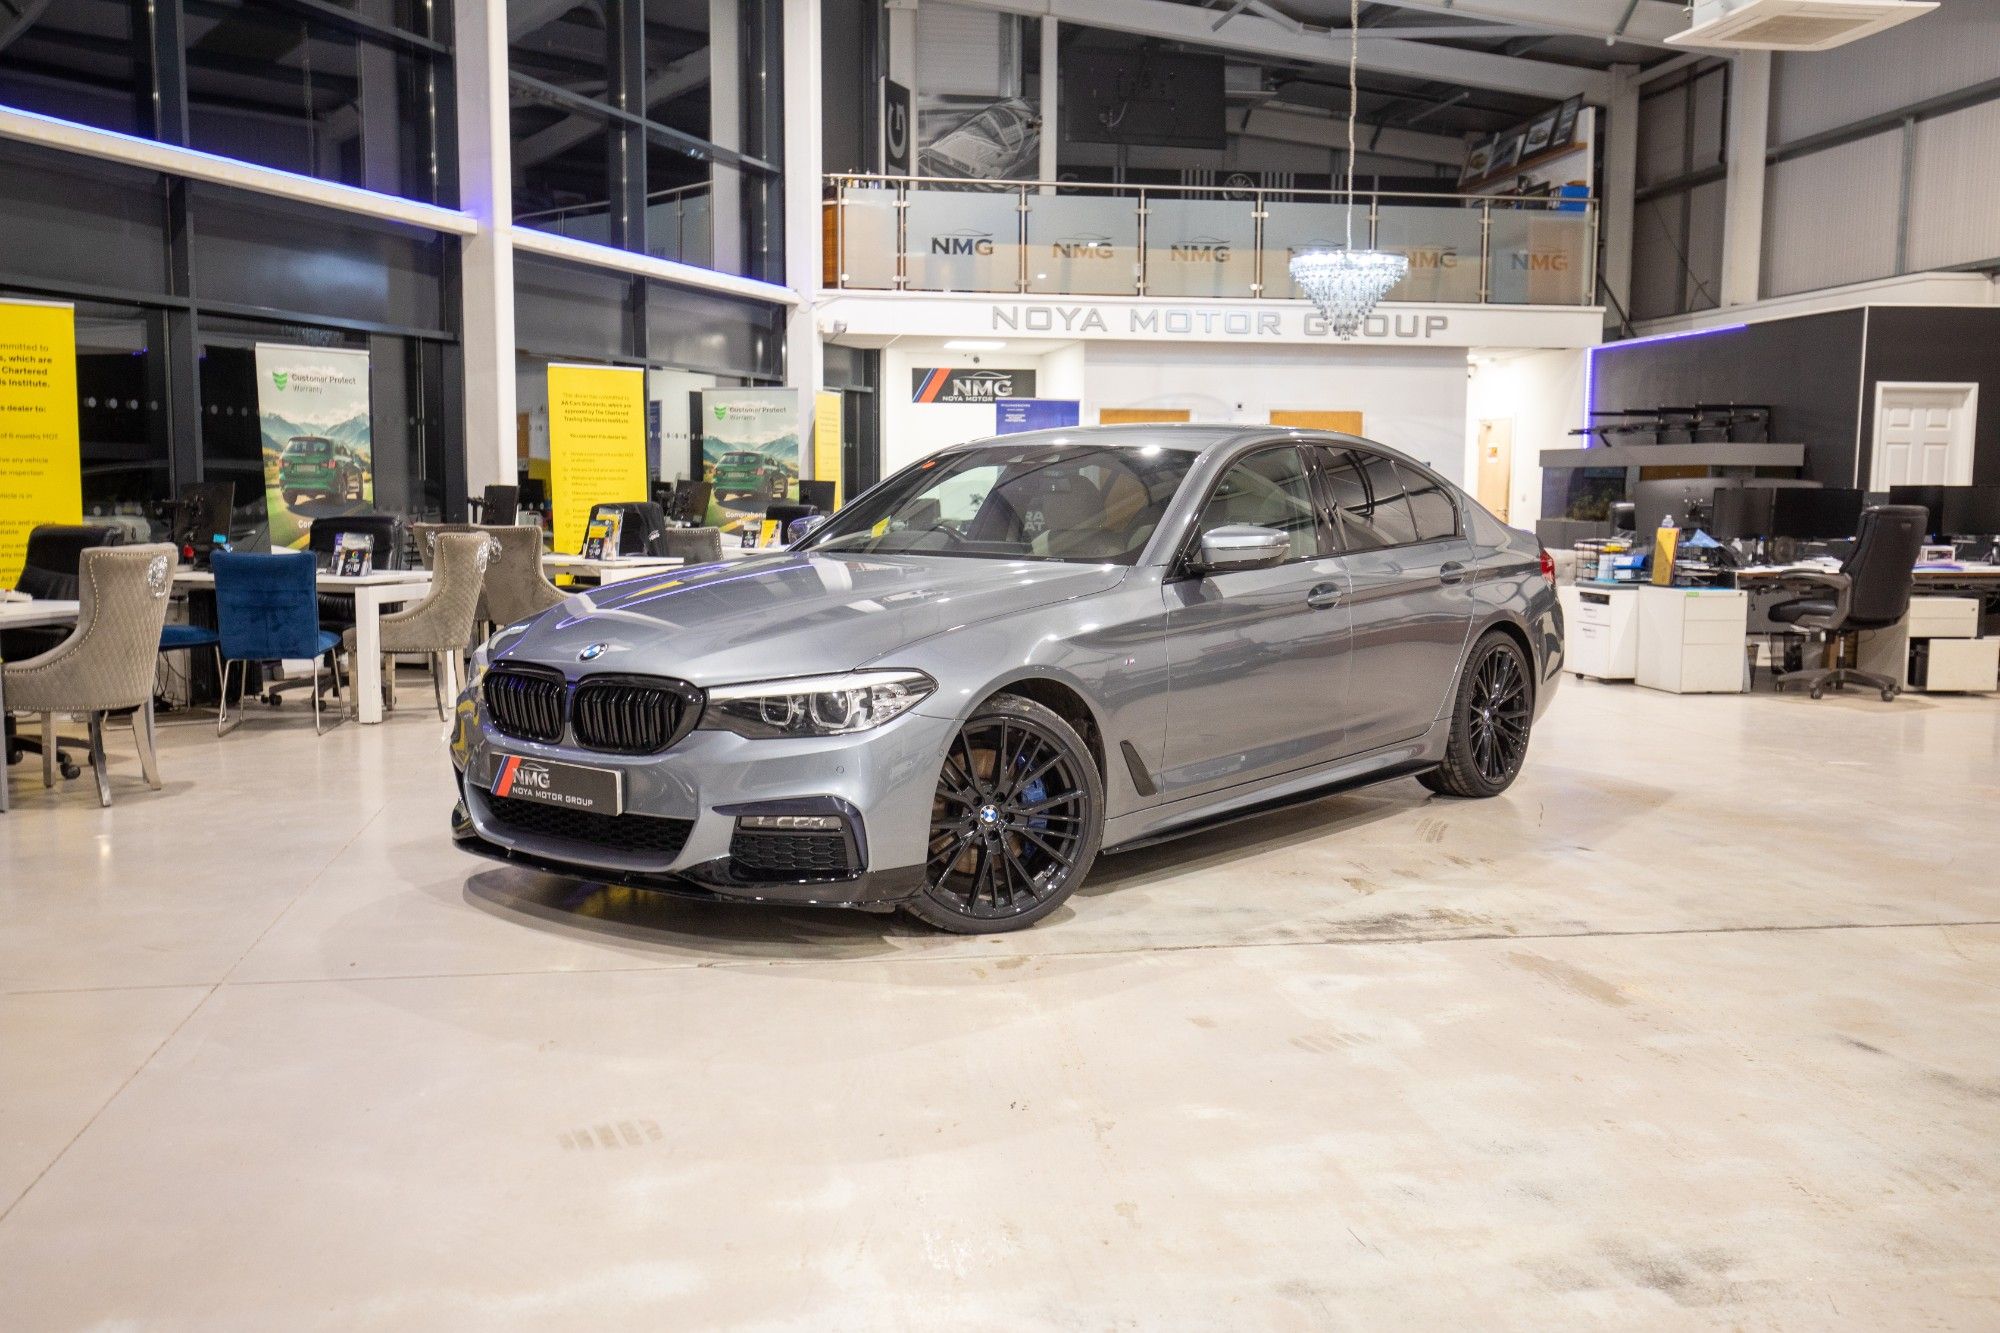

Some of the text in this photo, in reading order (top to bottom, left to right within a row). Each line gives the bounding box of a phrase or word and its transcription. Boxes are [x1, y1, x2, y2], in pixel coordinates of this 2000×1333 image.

[931, 237, 994, 255] NMG
[1052, 242, 1114, 258] NMG
[1170, 244, 1231, 262] NMG
[1511, 252, 1568, 271] NMG
[992, 306, 1449, 338] NOYA MOTOR GOUP
[39, 344, 49, 352] to
[9, 355, 36, 364] which
[2, 366, 48, 376] Chartered
[291, 373, 356, 385] Customer Protect
[293, 384, 323, 394] Warranty
[952, 379, 1013, 397] NMG
[7, 404, 33, 413] dealer
[512, 767, 551, 789] NMG
[512, 786, 593, 807] NOYA MOTOR GROUP
